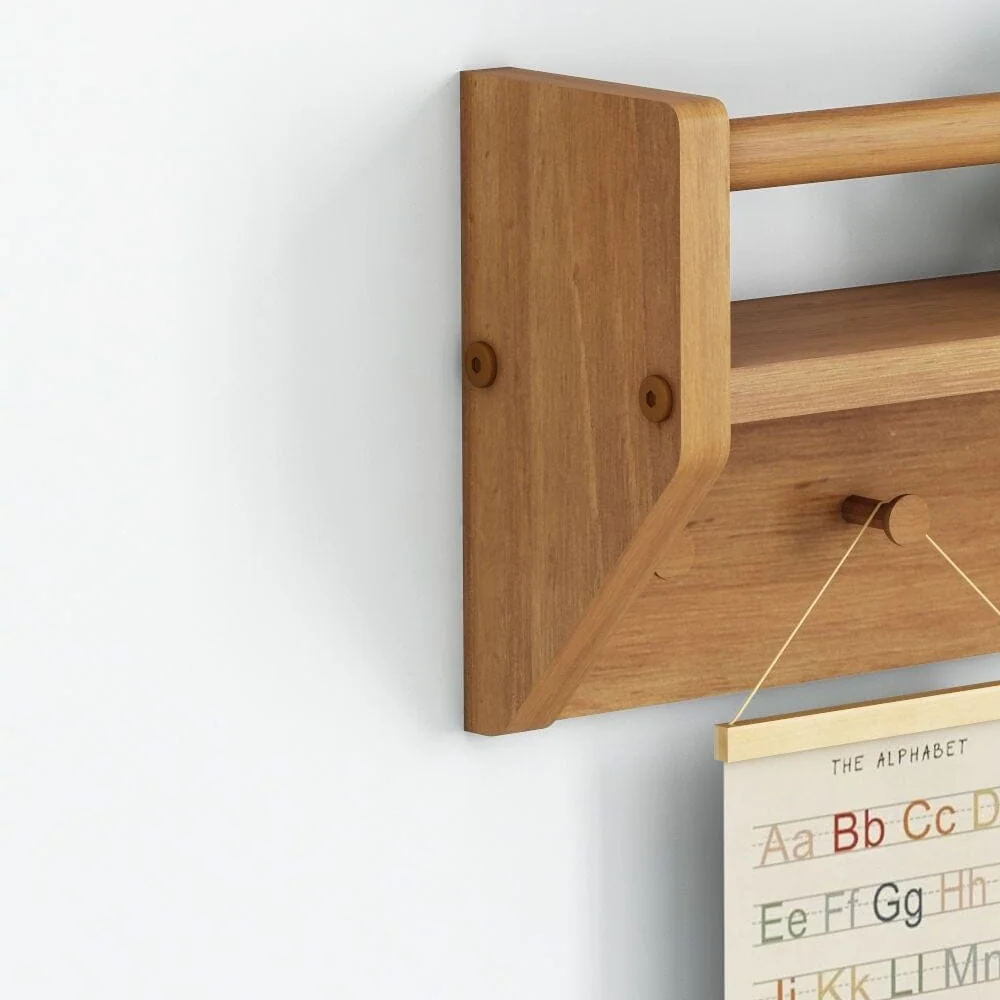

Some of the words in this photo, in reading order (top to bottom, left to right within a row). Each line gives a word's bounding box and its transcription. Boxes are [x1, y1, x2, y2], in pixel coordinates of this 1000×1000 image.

[831, 755, 865, 776] THE
[876, 738, 969, 769] ALPHABET
[760, 823, 814, 867] Aa
[833, 808, 886, 855] Bb
[902, 798, 957, 841] Cc
[760, 900, 808, 945] Ee
[824, 887, 860, 934] Ff
[872, 881, 924, 928] Gg
[939, 866, 987, 914] Hh
[890, 952, 924, 1000] Ll
